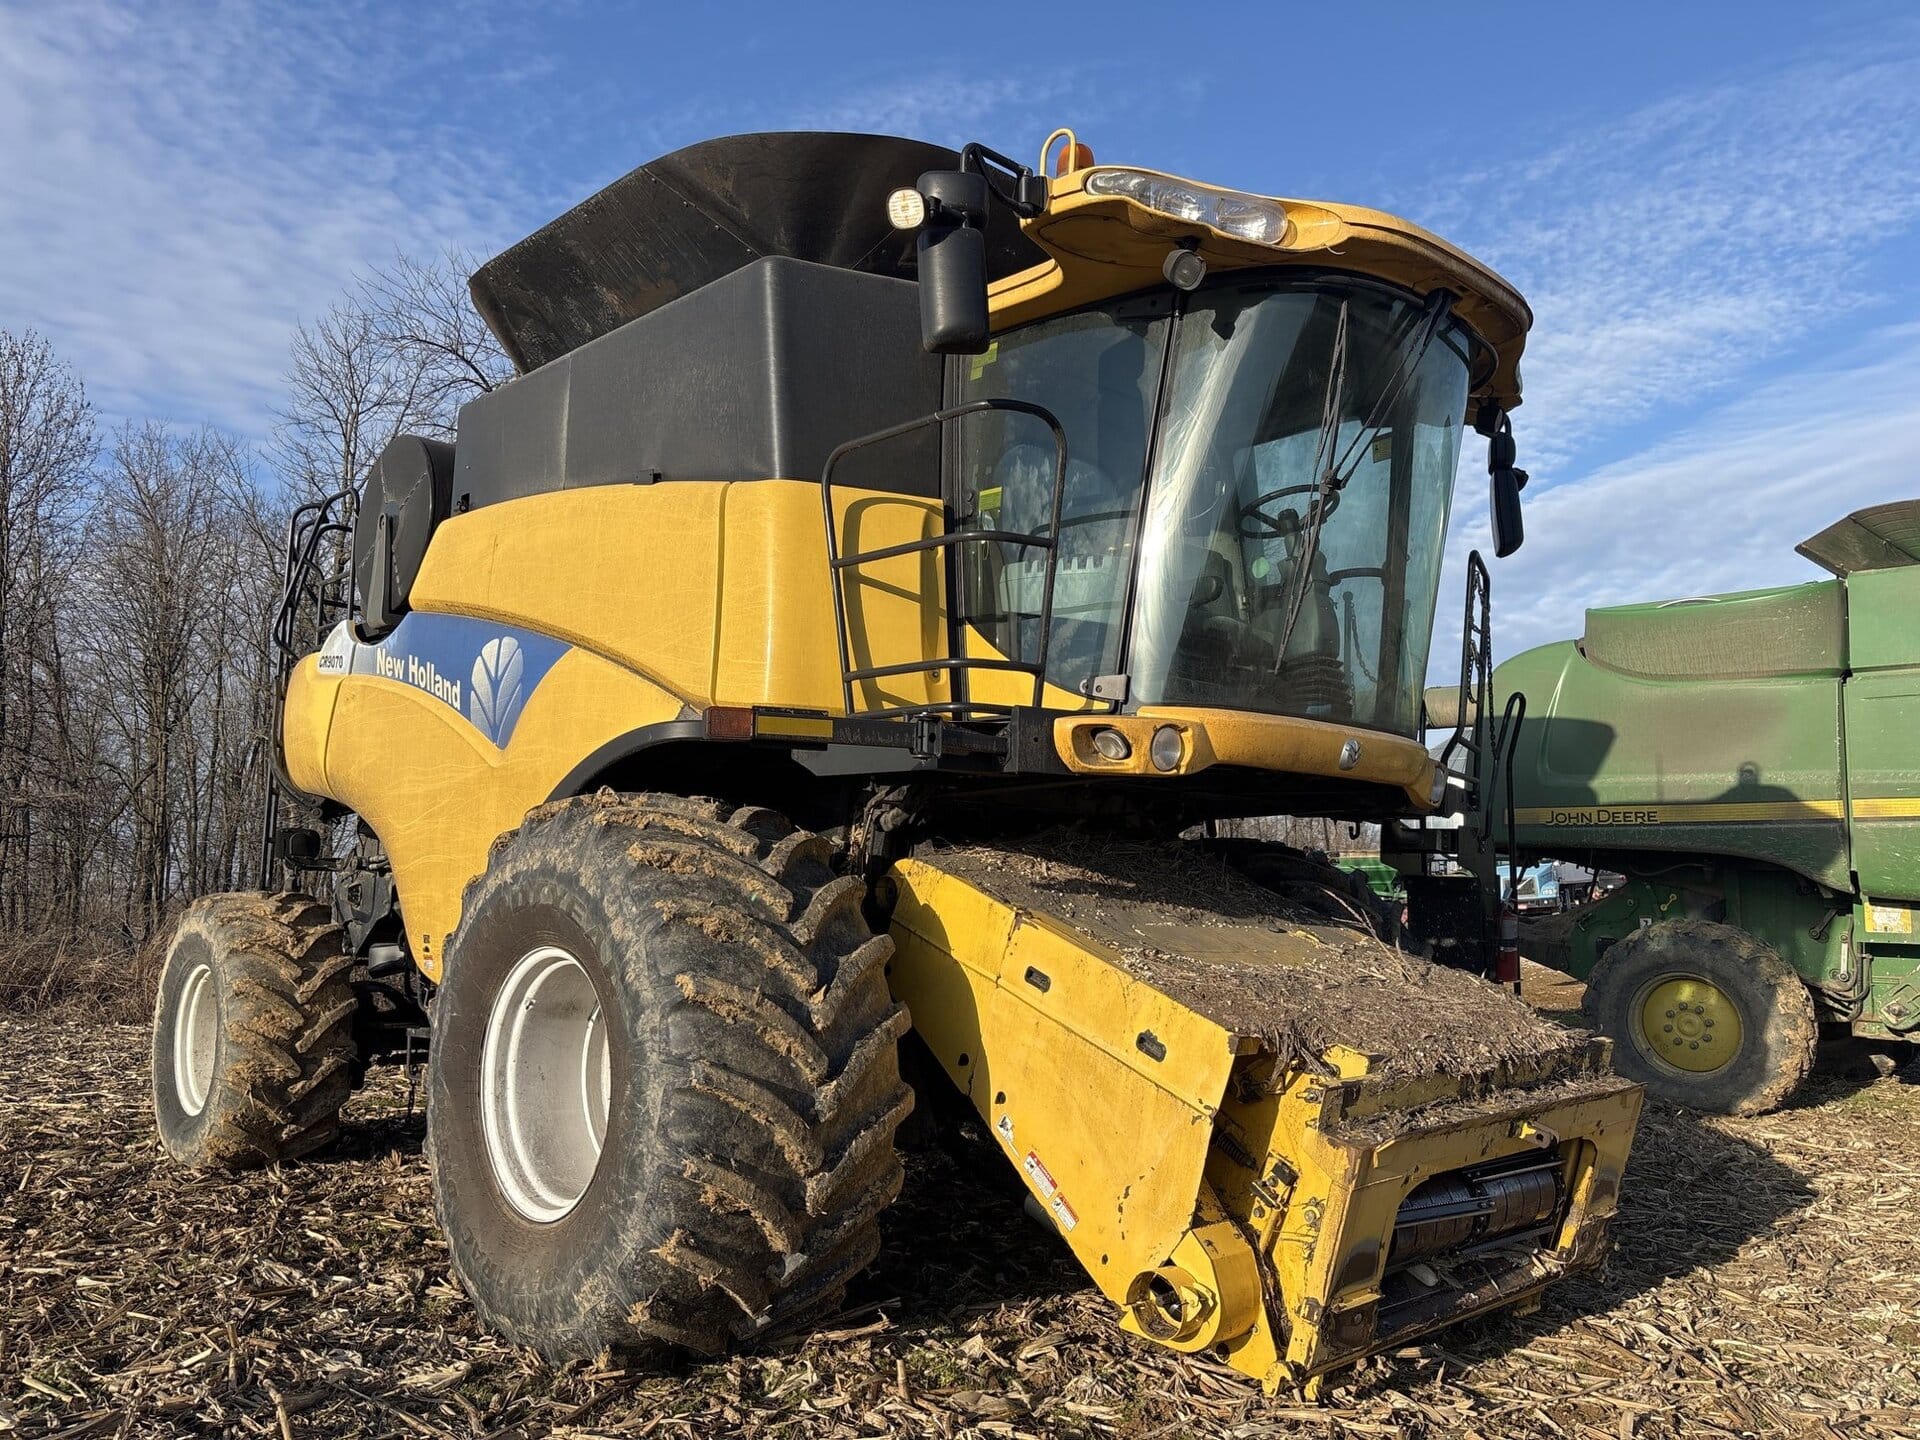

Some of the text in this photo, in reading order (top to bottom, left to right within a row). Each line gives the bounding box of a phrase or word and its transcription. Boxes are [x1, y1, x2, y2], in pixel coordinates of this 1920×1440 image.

[319, 655, 344, 669] CR9070
[376, 648, 461, 709] New Holland
[1546, 810, 1658, 824] JOHN DEERE
